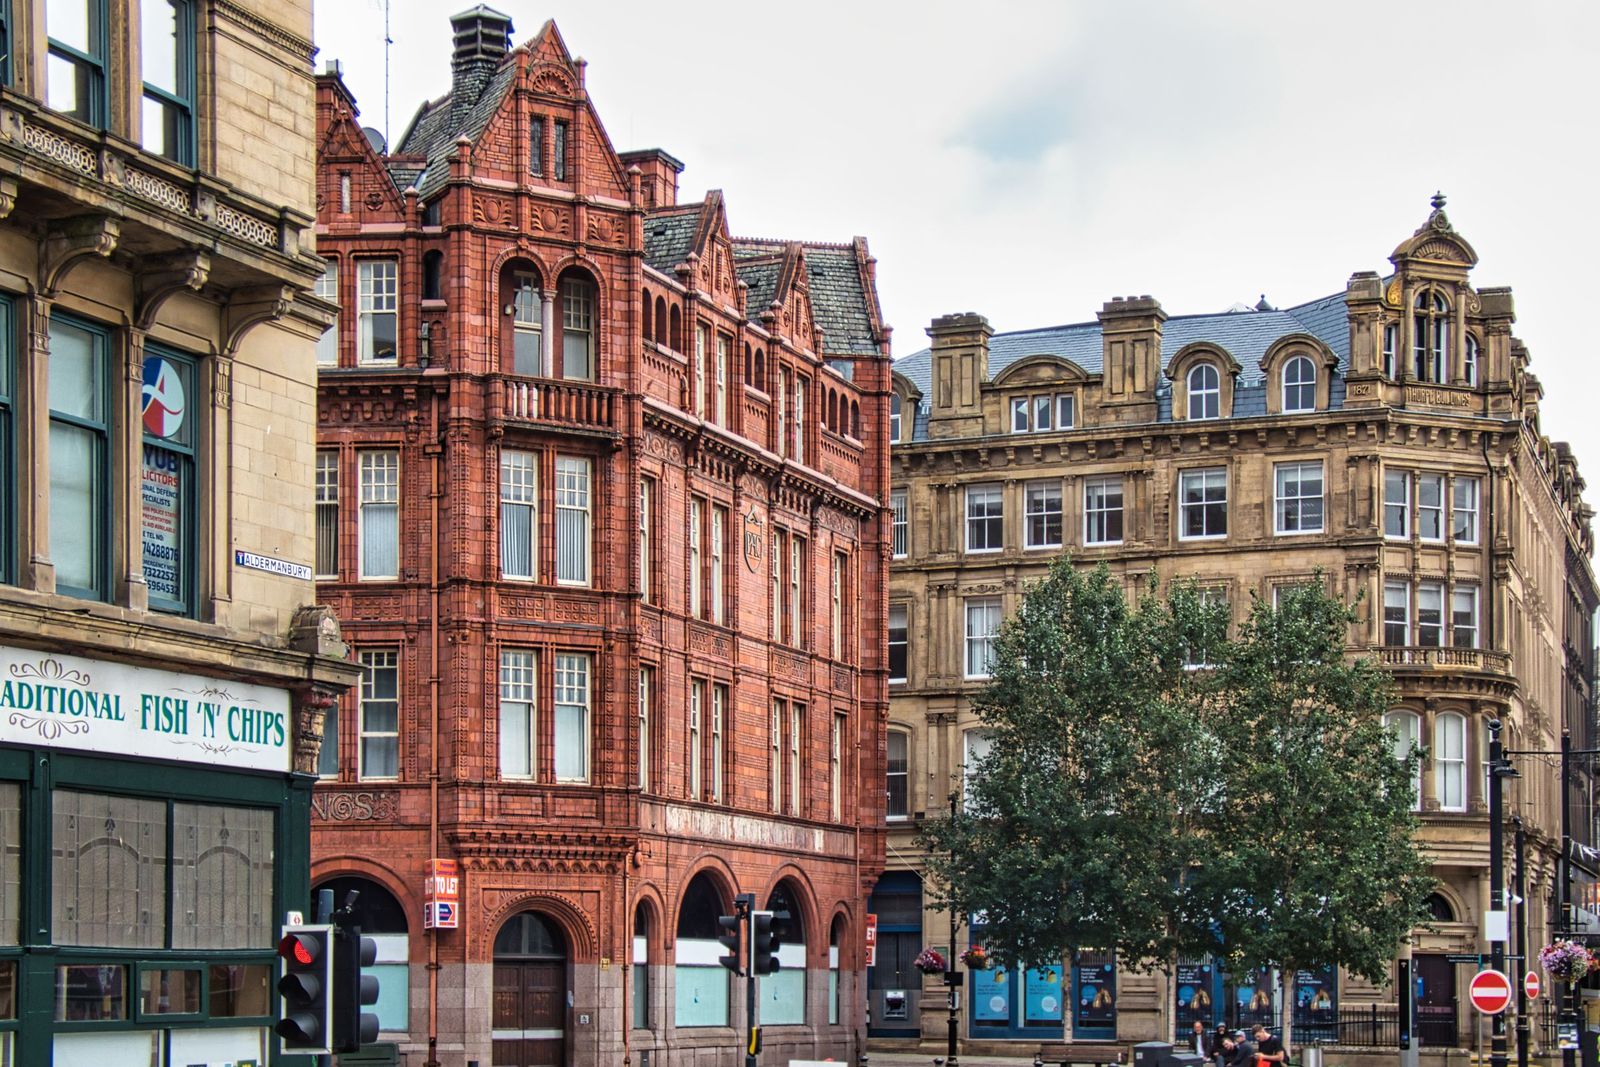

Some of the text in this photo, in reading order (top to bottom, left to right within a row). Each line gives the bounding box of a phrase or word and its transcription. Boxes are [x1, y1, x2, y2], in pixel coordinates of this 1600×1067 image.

[245, 554, 307, 578] ALDERMANBURY
[0, 680, 285, 747] ADITIONAL FISH 'N' CHIPS
[436, 877, 446, 894] TO
[446, 877, 459, 895] LET
